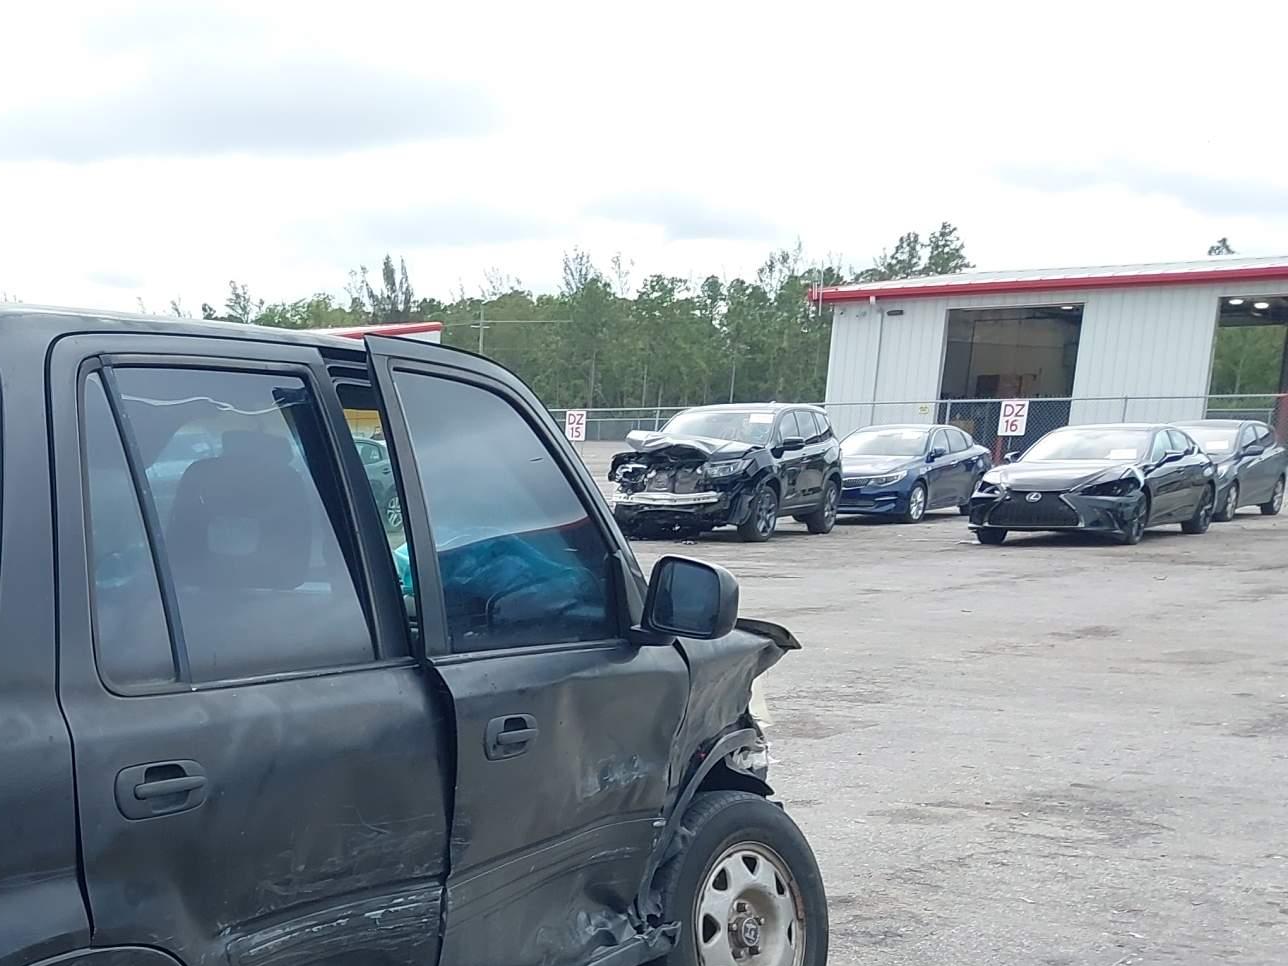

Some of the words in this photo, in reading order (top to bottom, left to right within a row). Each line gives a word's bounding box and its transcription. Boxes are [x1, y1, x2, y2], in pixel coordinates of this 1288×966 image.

[1003, 403, 1025, 417] DZ
[567, 413, 584, 425] DZ
[1004, 419, 1018, 432] 16
[570, 426, 581, 438] 15
